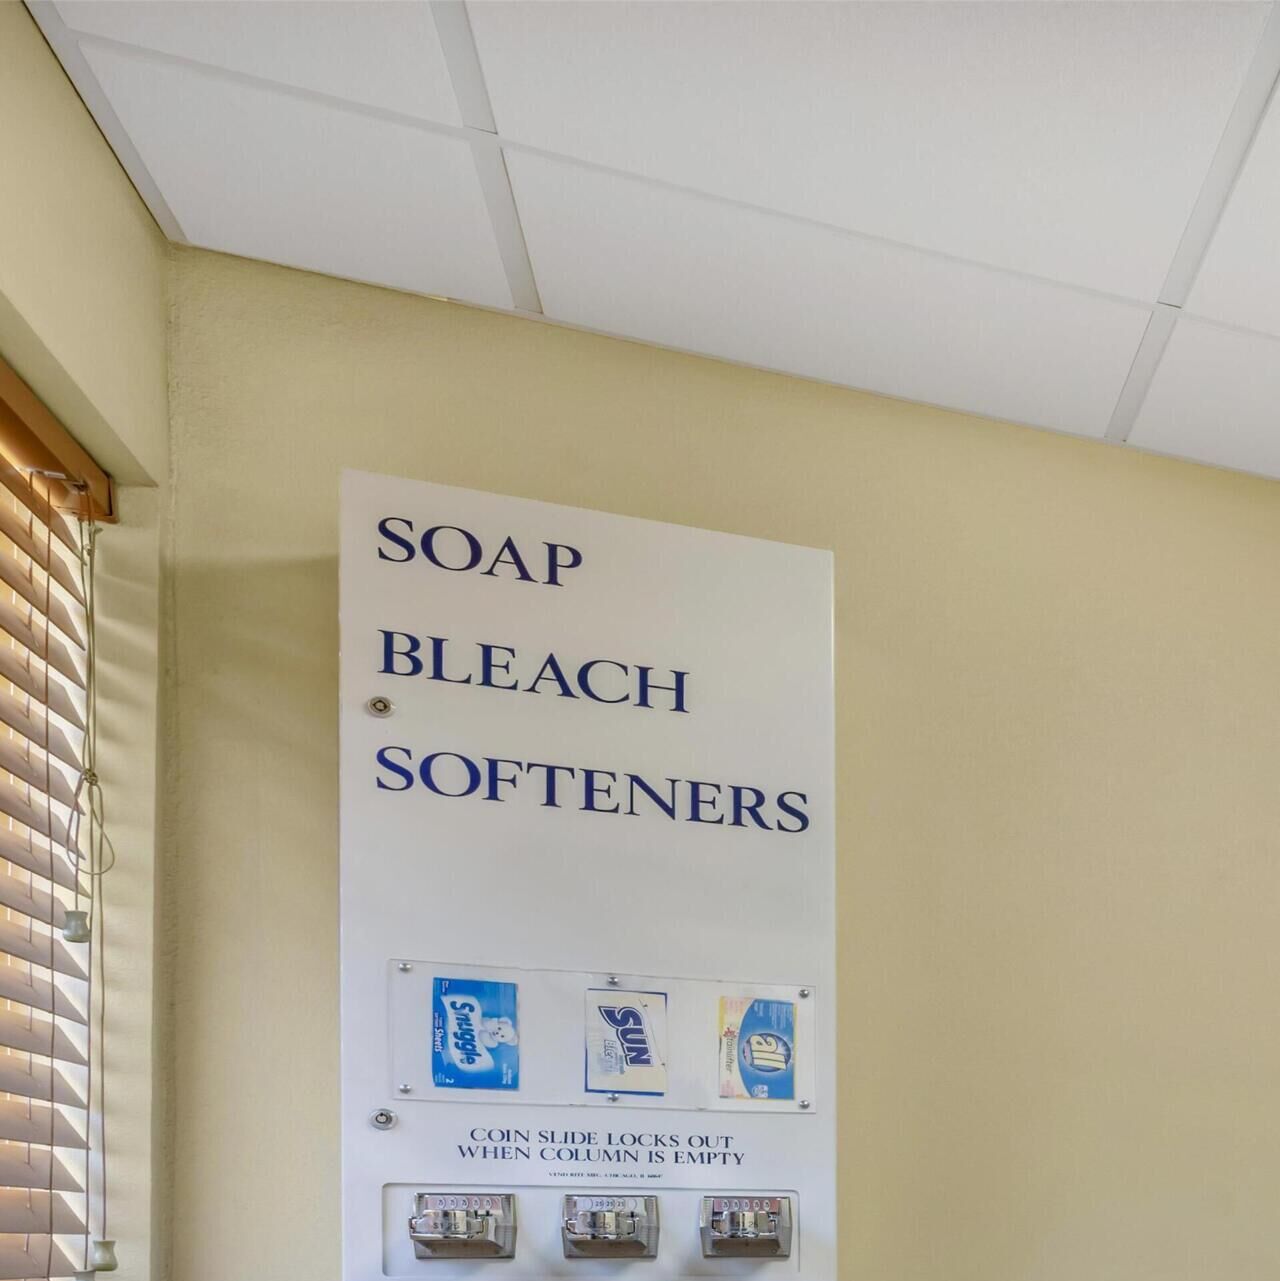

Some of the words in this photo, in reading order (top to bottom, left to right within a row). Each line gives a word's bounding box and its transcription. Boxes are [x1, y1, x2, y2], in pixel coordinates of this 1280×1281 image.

[376, 516, 583, 588] SOAP
[376, 628, 691, 714] BLEACH
[375, 745, 810, 834] SOFTENERS
[449, 1000, 482, 1065] Snuggle
[598, 1005, 654, 1067] SUN
[750, 1034, 787, 1071] all
[457, 1144, 530, 1160] WHEN
[540, 1147, 639, 1162] COLUMN
[648, 1150, 665, 1164] IS
[674, 1151, 744, 1165] EMPTY
[470, 1127, 530, 1143] COIN
[538, 1129, 599, 1145] SLIDE
[607, 1132, 680, 1148] LOCKS
[688, 1134, 734, 1149] OUT
